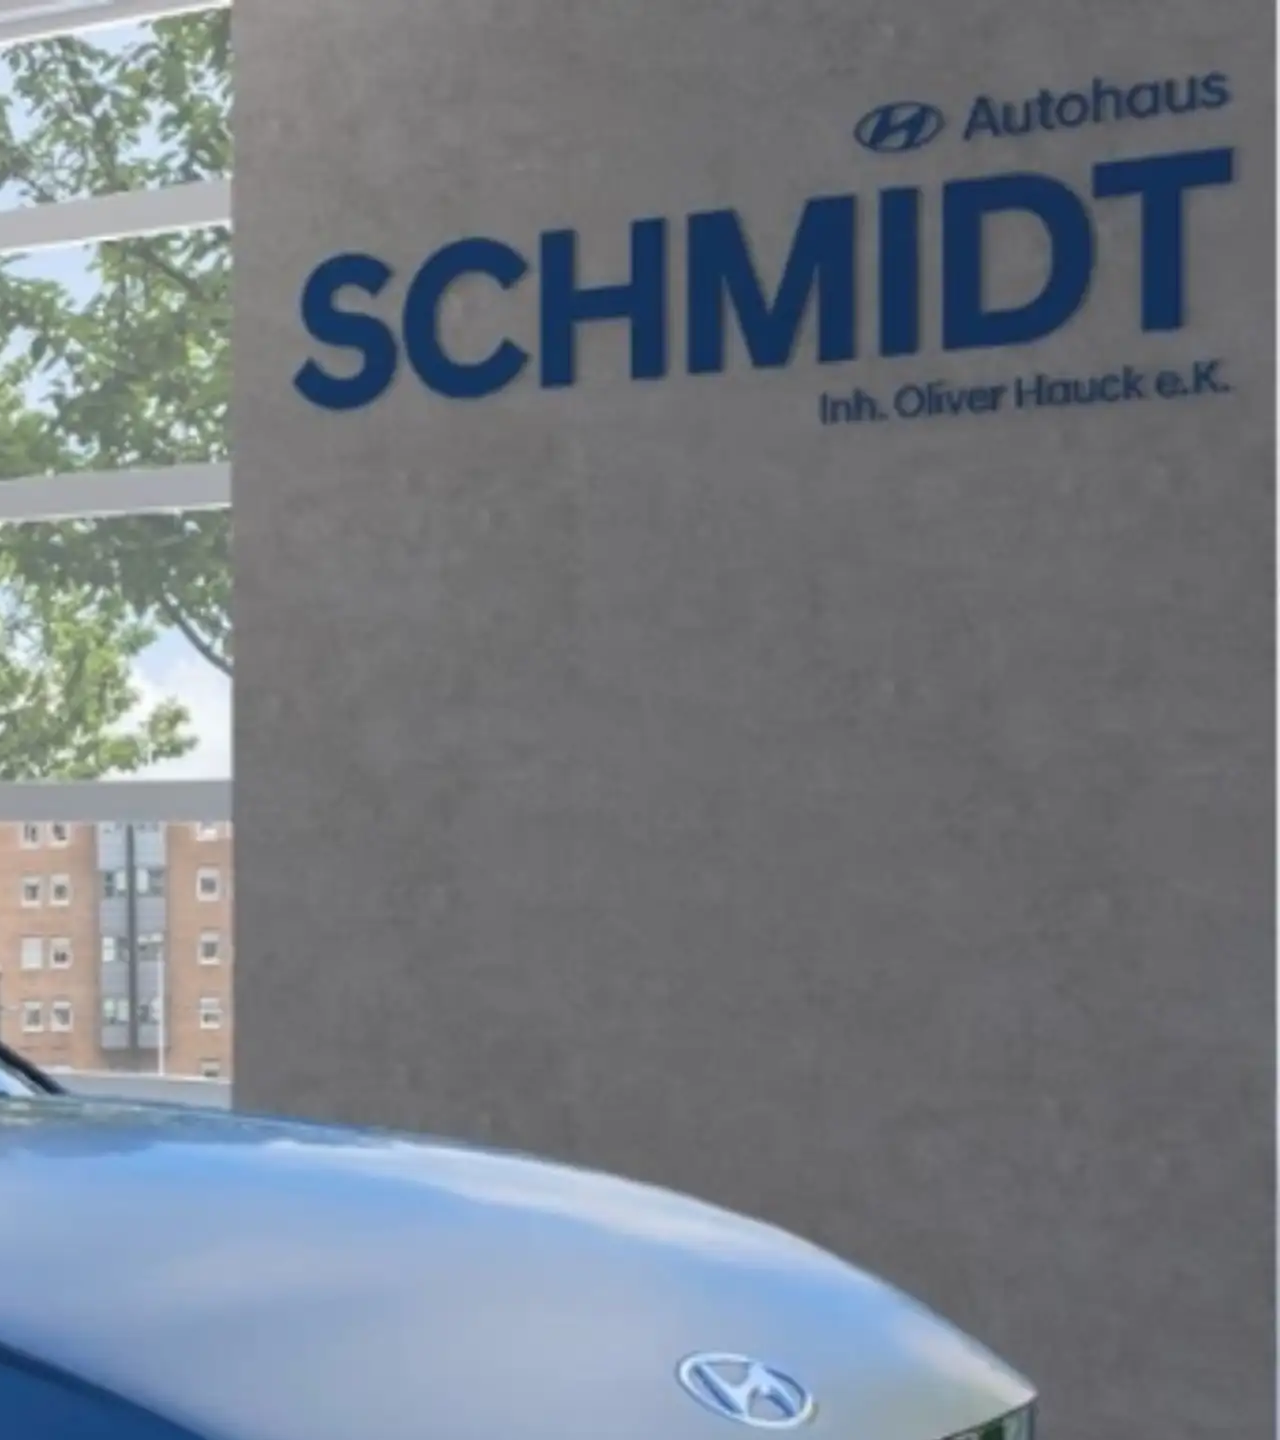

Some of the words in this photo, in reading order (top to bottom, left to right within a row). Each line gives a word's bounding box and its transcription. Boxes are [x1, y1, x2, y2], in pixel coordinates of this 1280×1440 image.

[962, 71, 1230, 141] Autohaus
[292, 147, 1236, 411] SCHMIDT
[819, 388, 889, 426] Inh.
[893, 381, 1007, 420] Oliver
[1013, 364, 1144, 410] Hauck
[1153, 357, 1233, 400] e.K.
